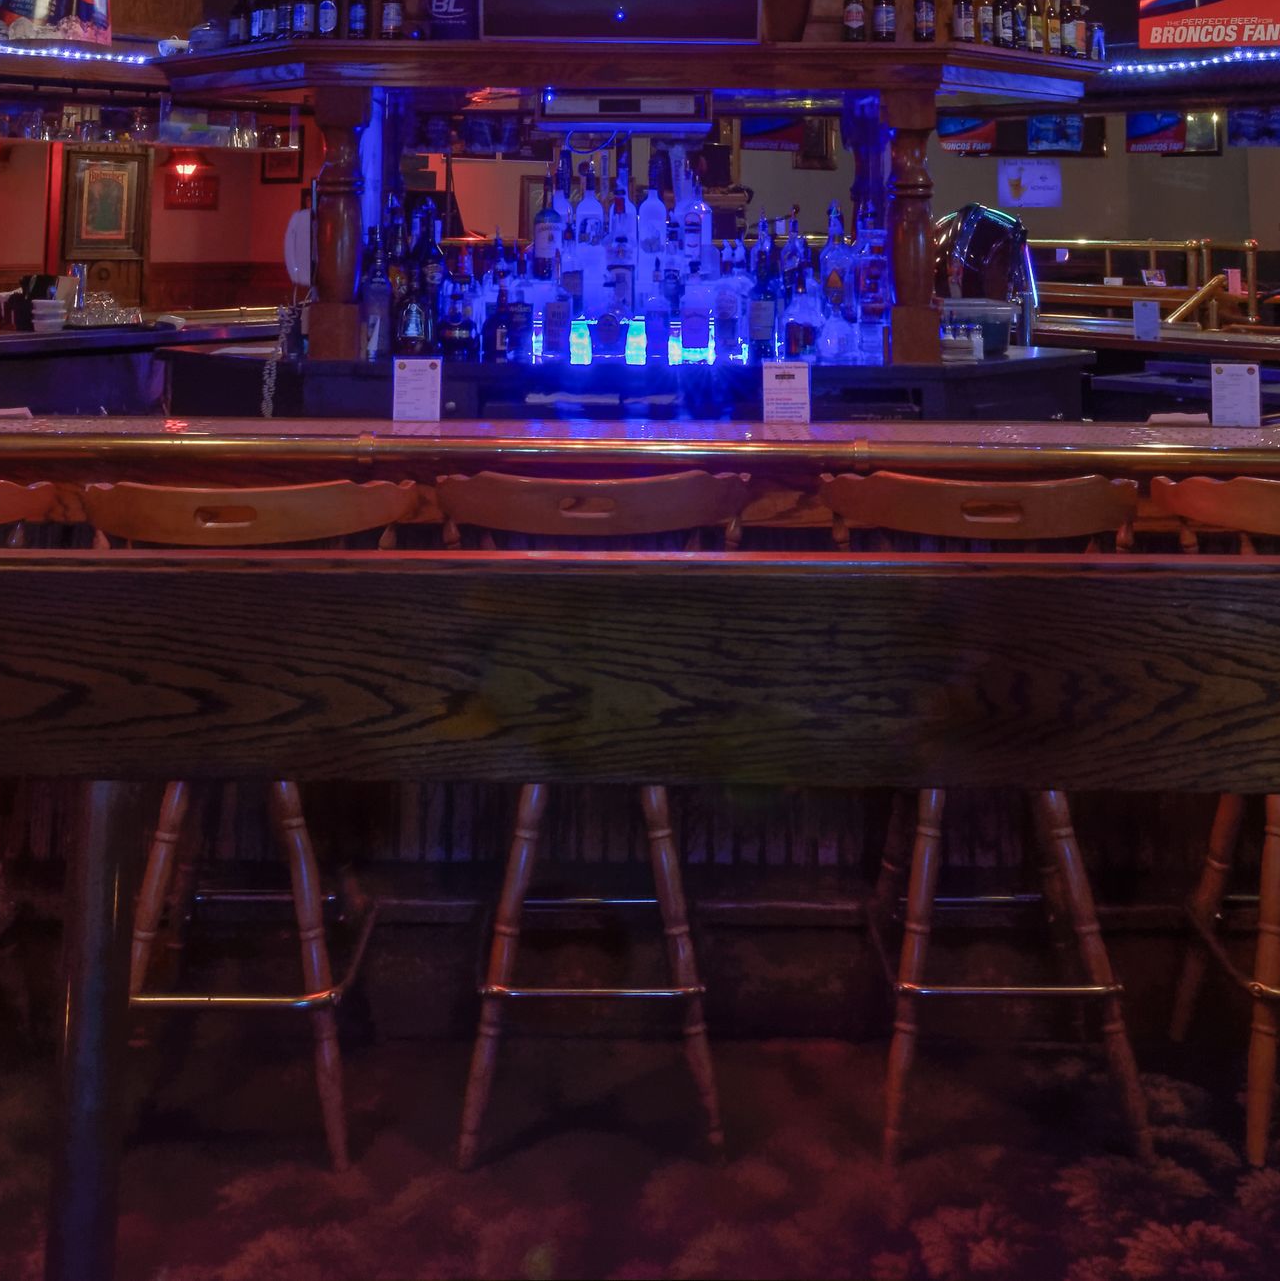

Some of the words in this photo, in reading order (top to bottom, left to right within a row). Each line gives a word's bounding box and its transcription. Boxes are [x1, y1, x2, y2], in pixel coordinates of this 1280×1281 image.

[1181, 18, 1228, 26] PERFECT
[1230, 17, 1258, 25] BEER
[1150, 25, 1238, 44] BRONCOS
